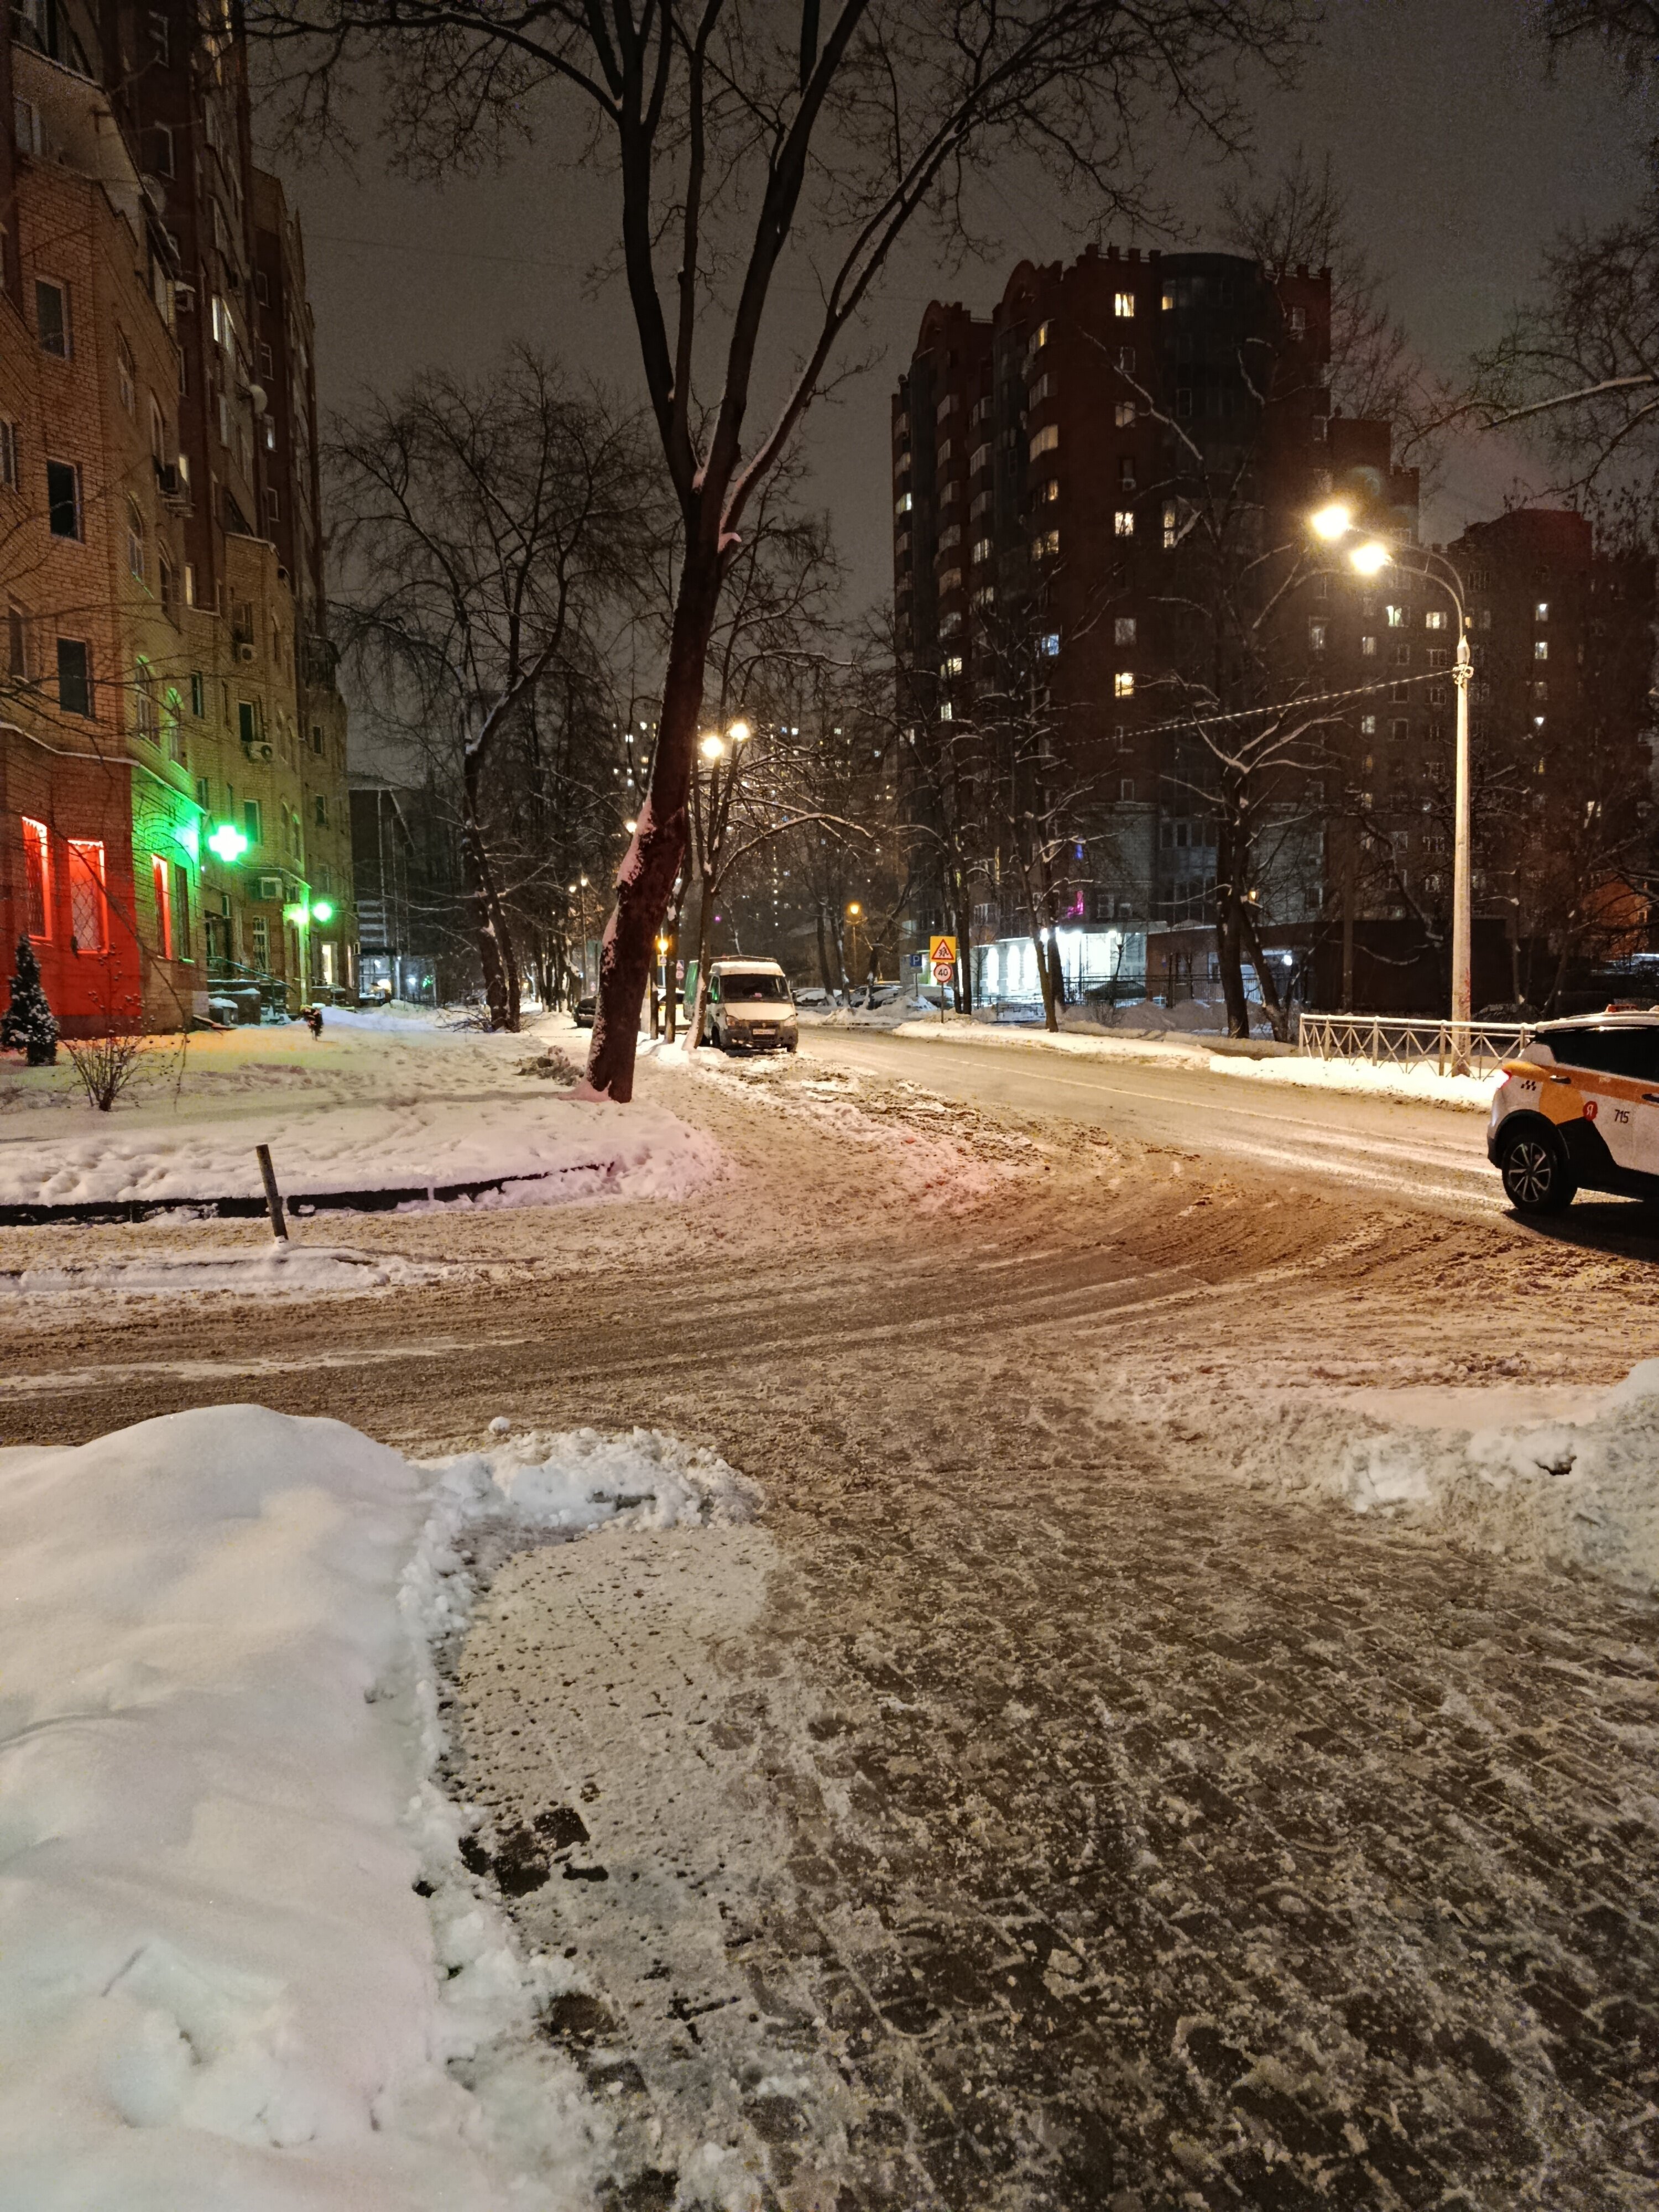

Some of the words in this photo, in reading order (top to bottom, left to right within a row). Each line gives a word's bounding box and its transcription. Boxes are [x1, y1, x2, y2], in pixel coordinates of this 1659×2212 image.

[913, 955, 920, 966] P
[1587, 1104, 1594, 1116] Я
[1614, 1109, 1630, 1124] 715
